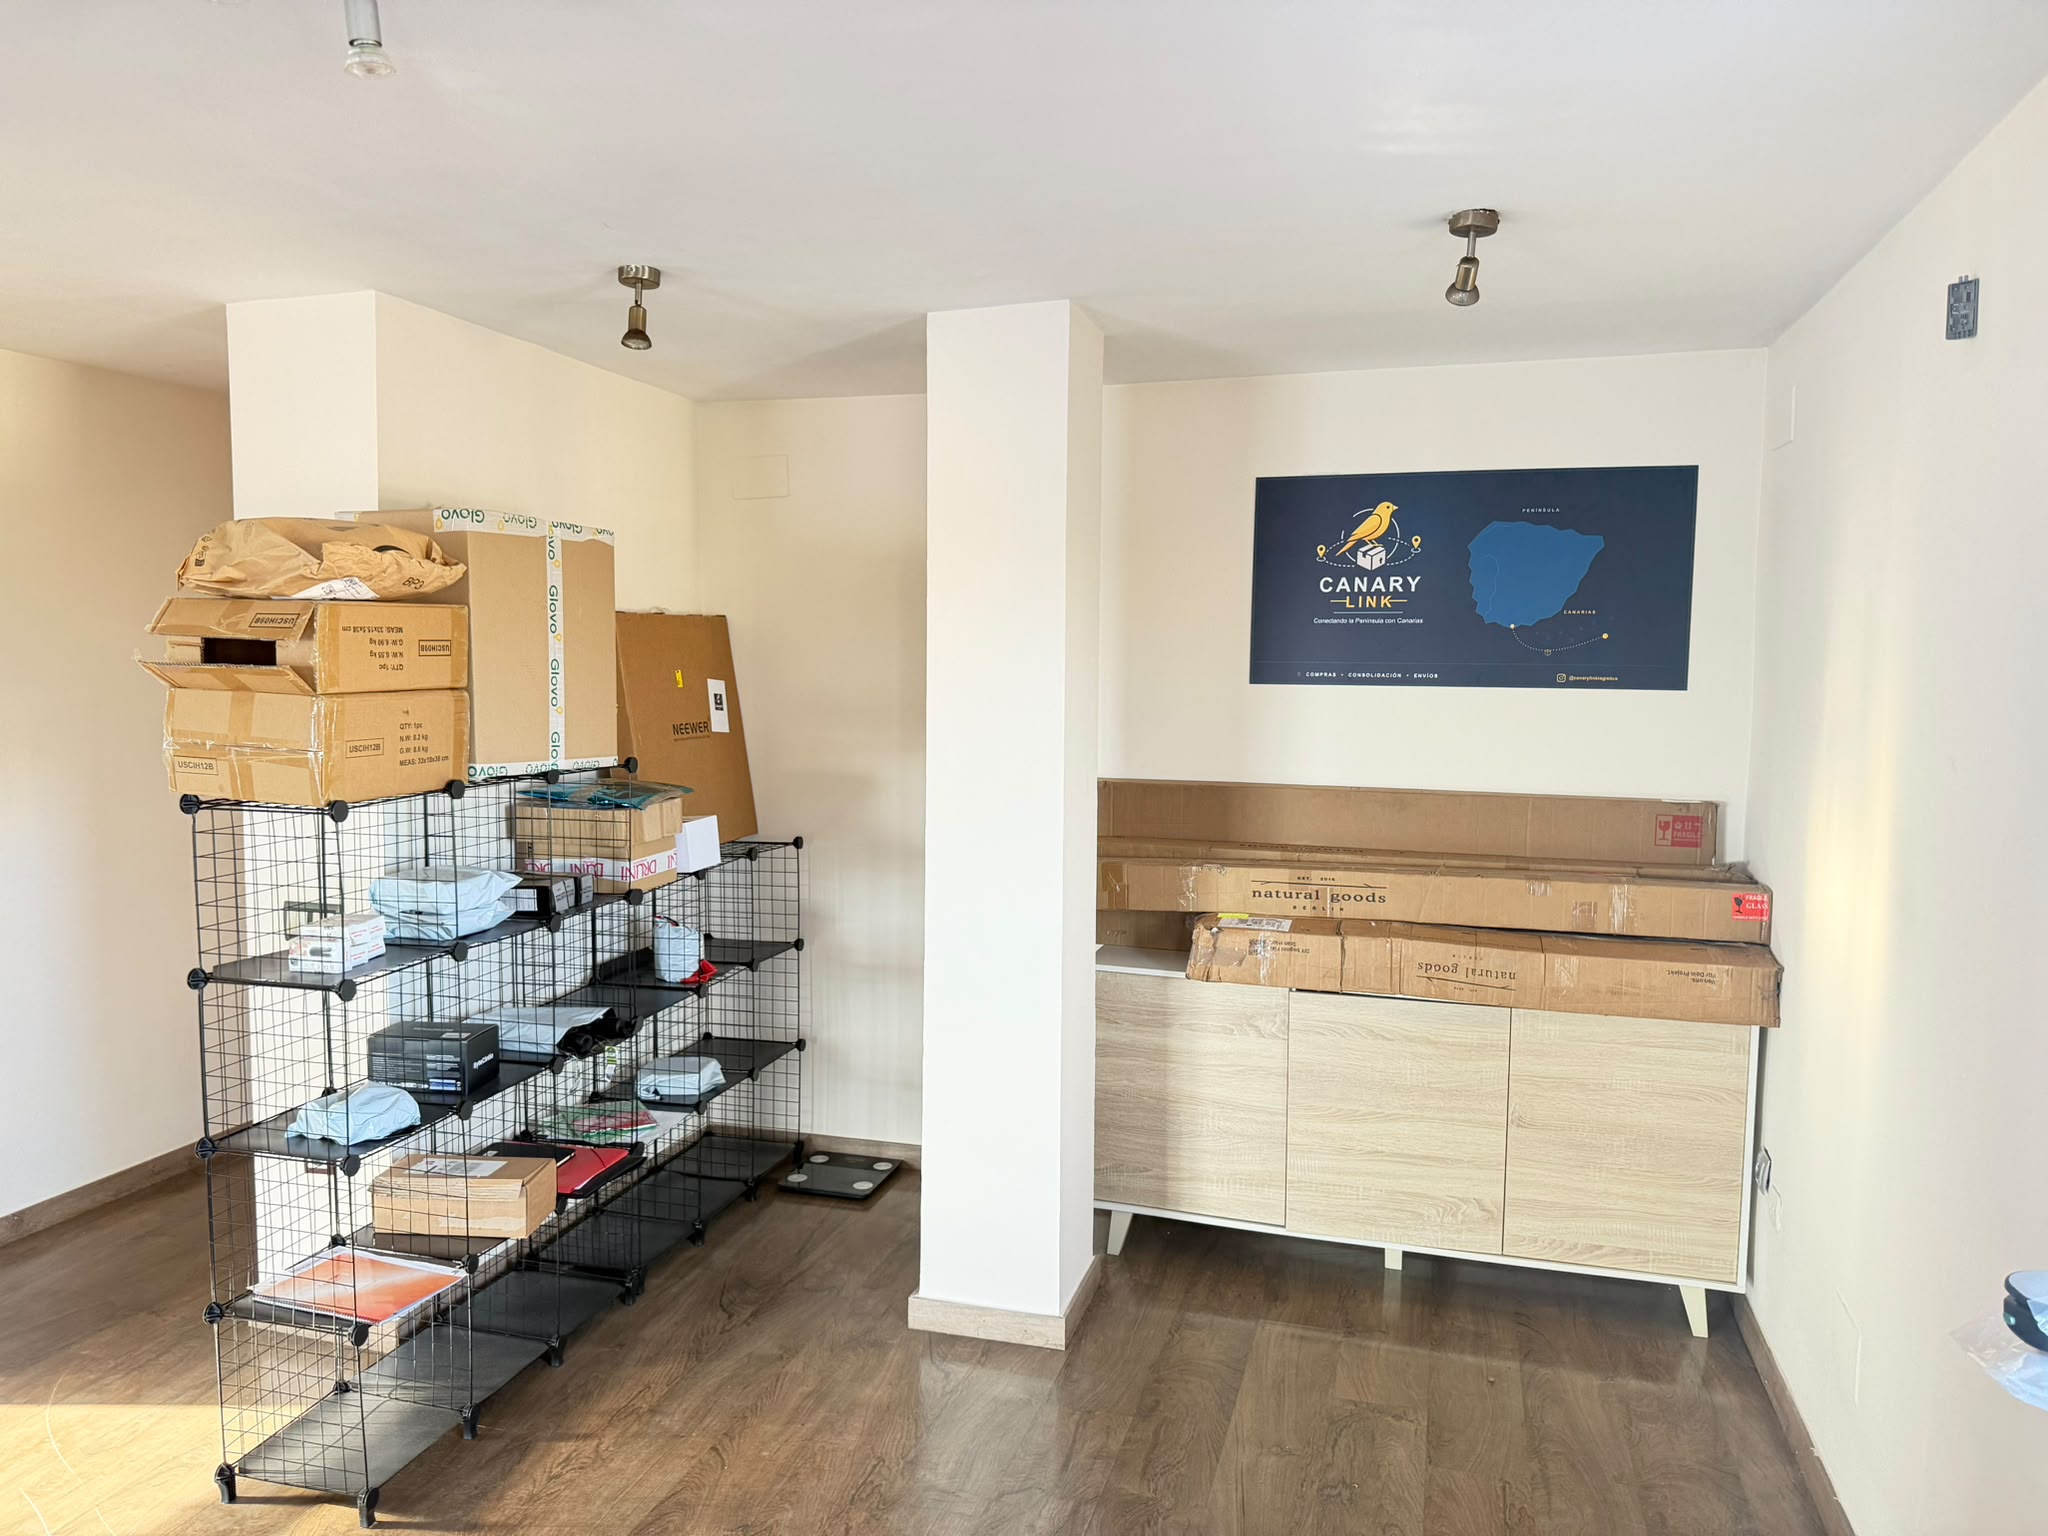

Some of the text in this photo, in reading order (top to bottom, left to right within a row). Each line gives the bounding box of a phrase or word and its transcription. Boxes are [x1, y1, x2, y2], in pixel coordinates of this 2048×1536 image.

[441, 509, 485, 524] Glovo
[502, 512, 537, 529] Glovo
[1319, 576, 1421, 593] CANARY
[1345, 595, 1392, 608] LINK
[549, 585, 558, 634] Glovo
[420, 644, 450, 652] USCIH09B
[550, 658, 560, 707] Glovo
[672, 720, 710, 736] NEEWER
[349, 743, 381, 753] USCIH12B
[177, 760, 214, 770] USCIH12B
[1251, 889, 1386, 904] natural goods
[1417, 962, 1516, 980] natural goods
